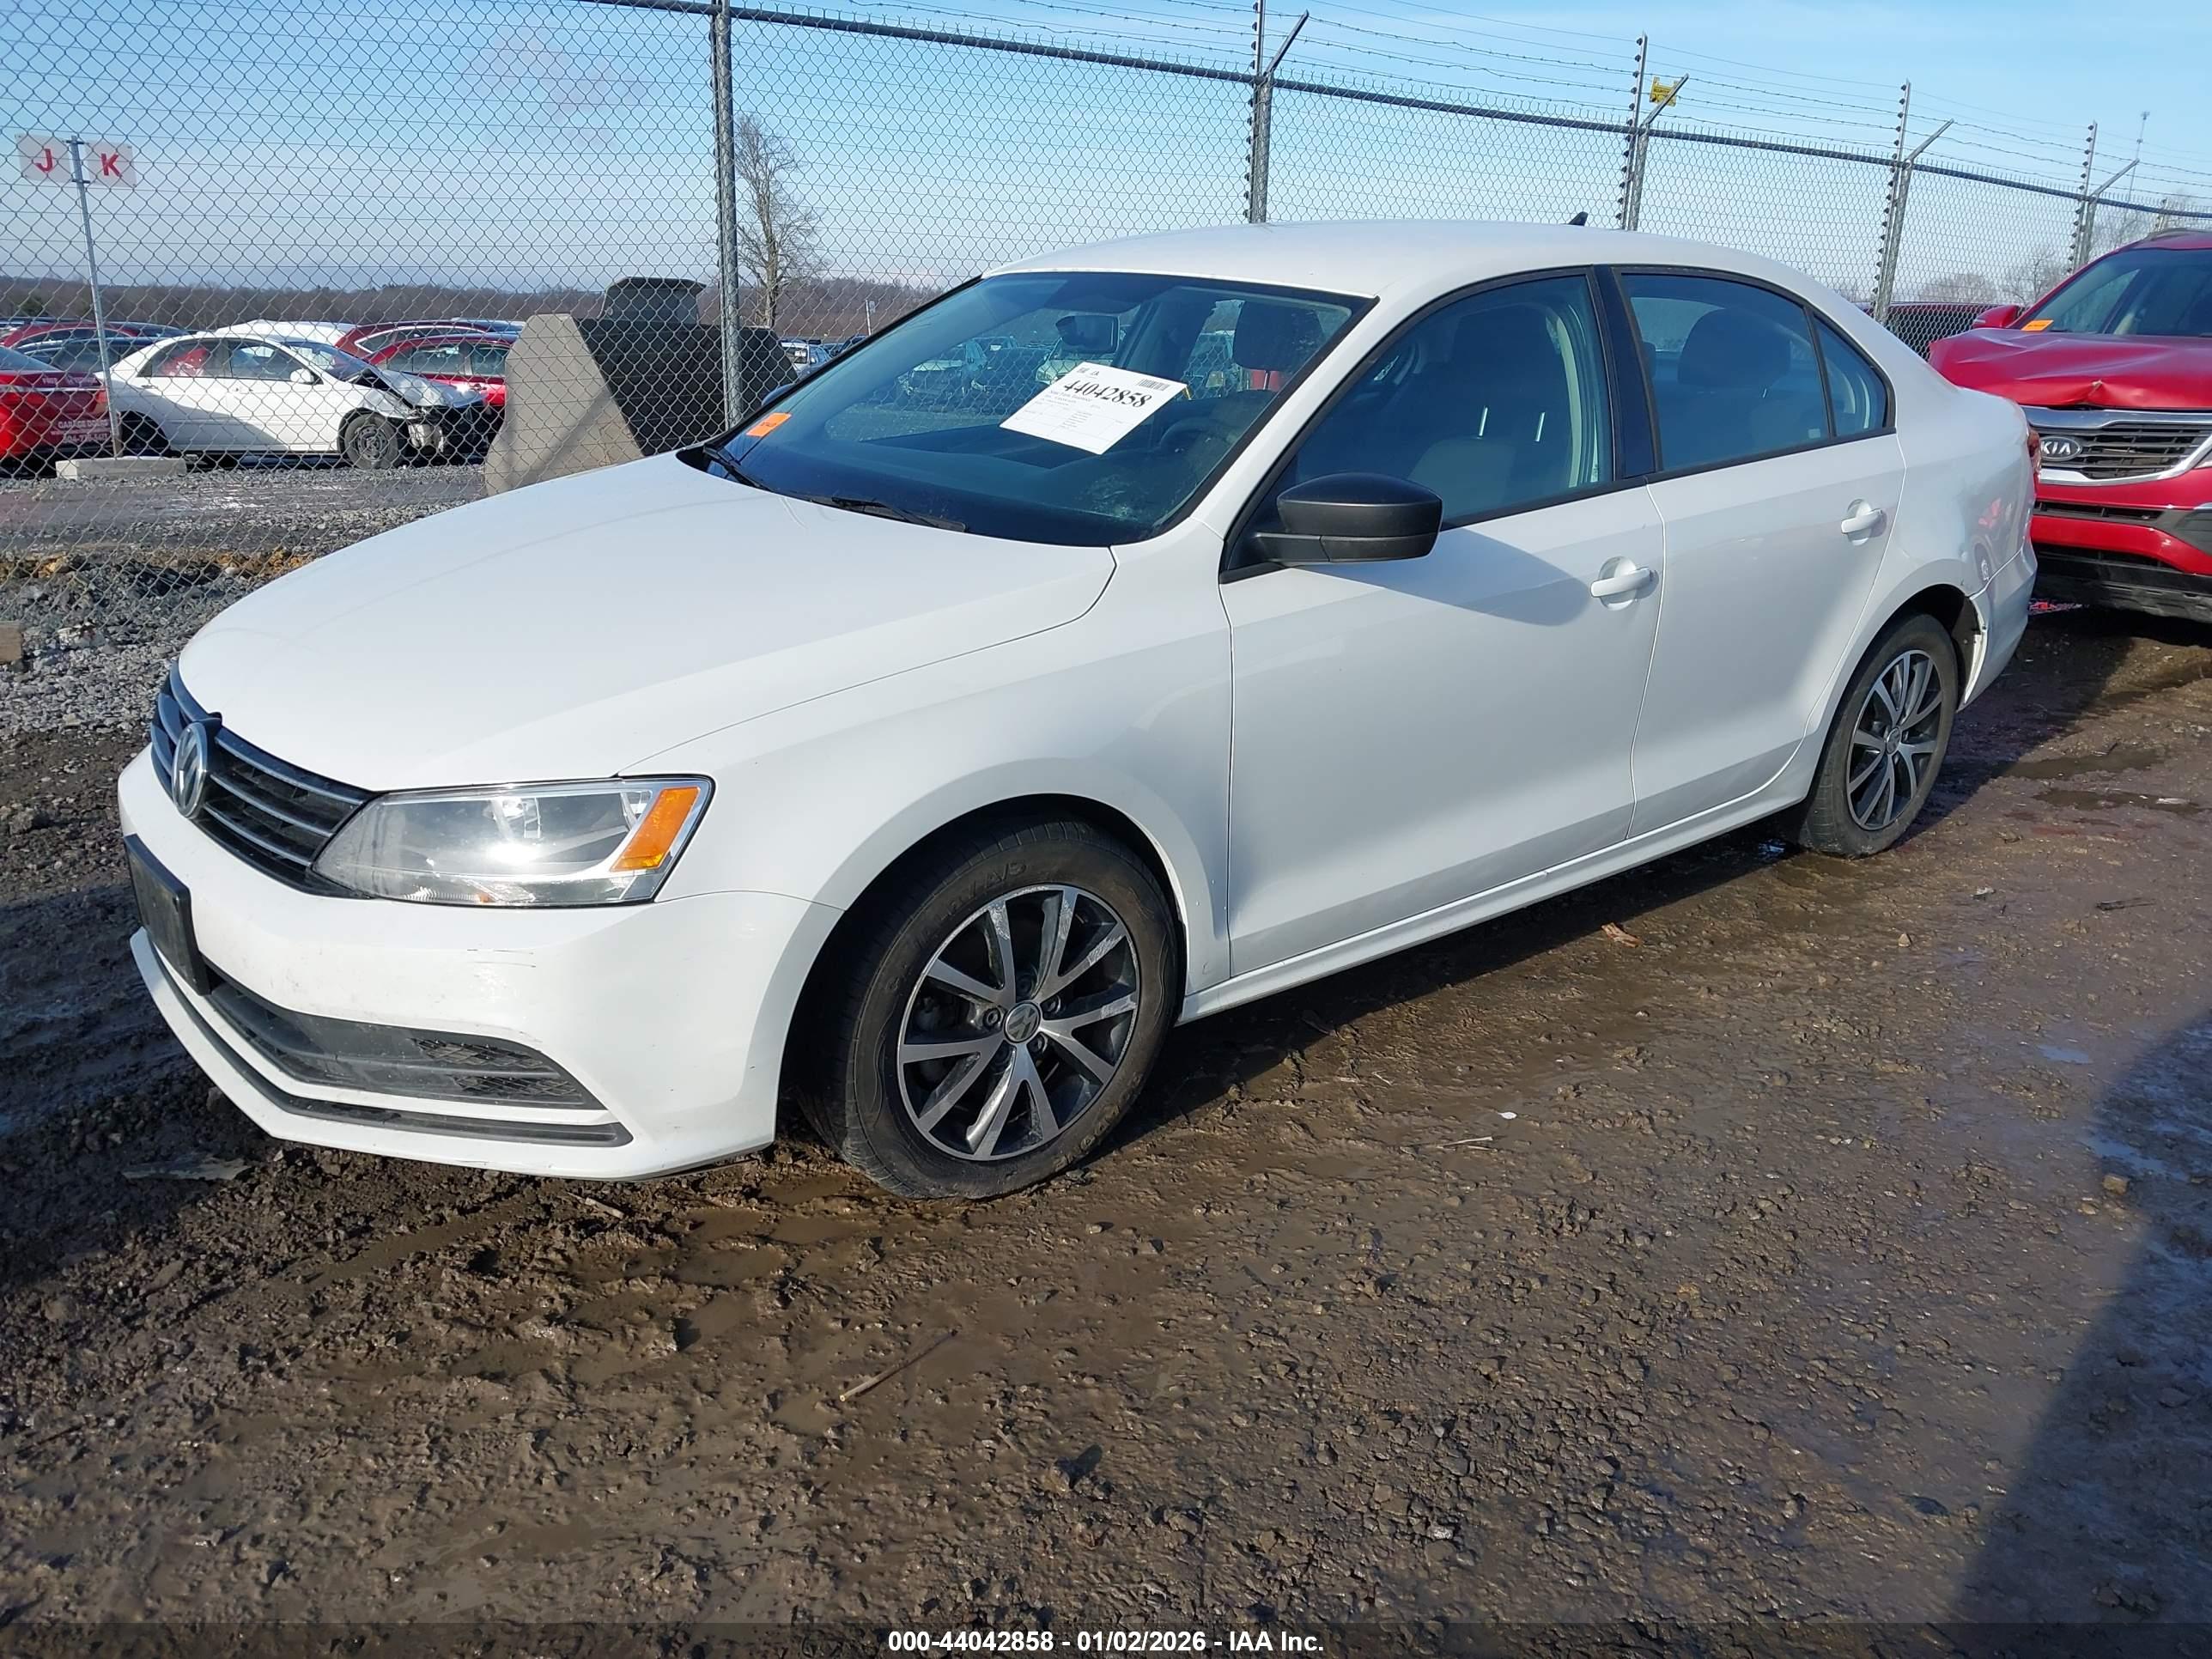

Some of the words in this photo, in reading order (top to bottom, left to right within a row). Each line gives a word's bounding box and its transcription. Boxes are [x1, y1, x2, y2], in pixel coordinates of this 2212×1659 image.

[34, 148, 53, 173] J
[100, 152, 122, 179] K
[1064, 380, 1152, 407] 44042858
[2040, 441, 2071, 455] KIA
